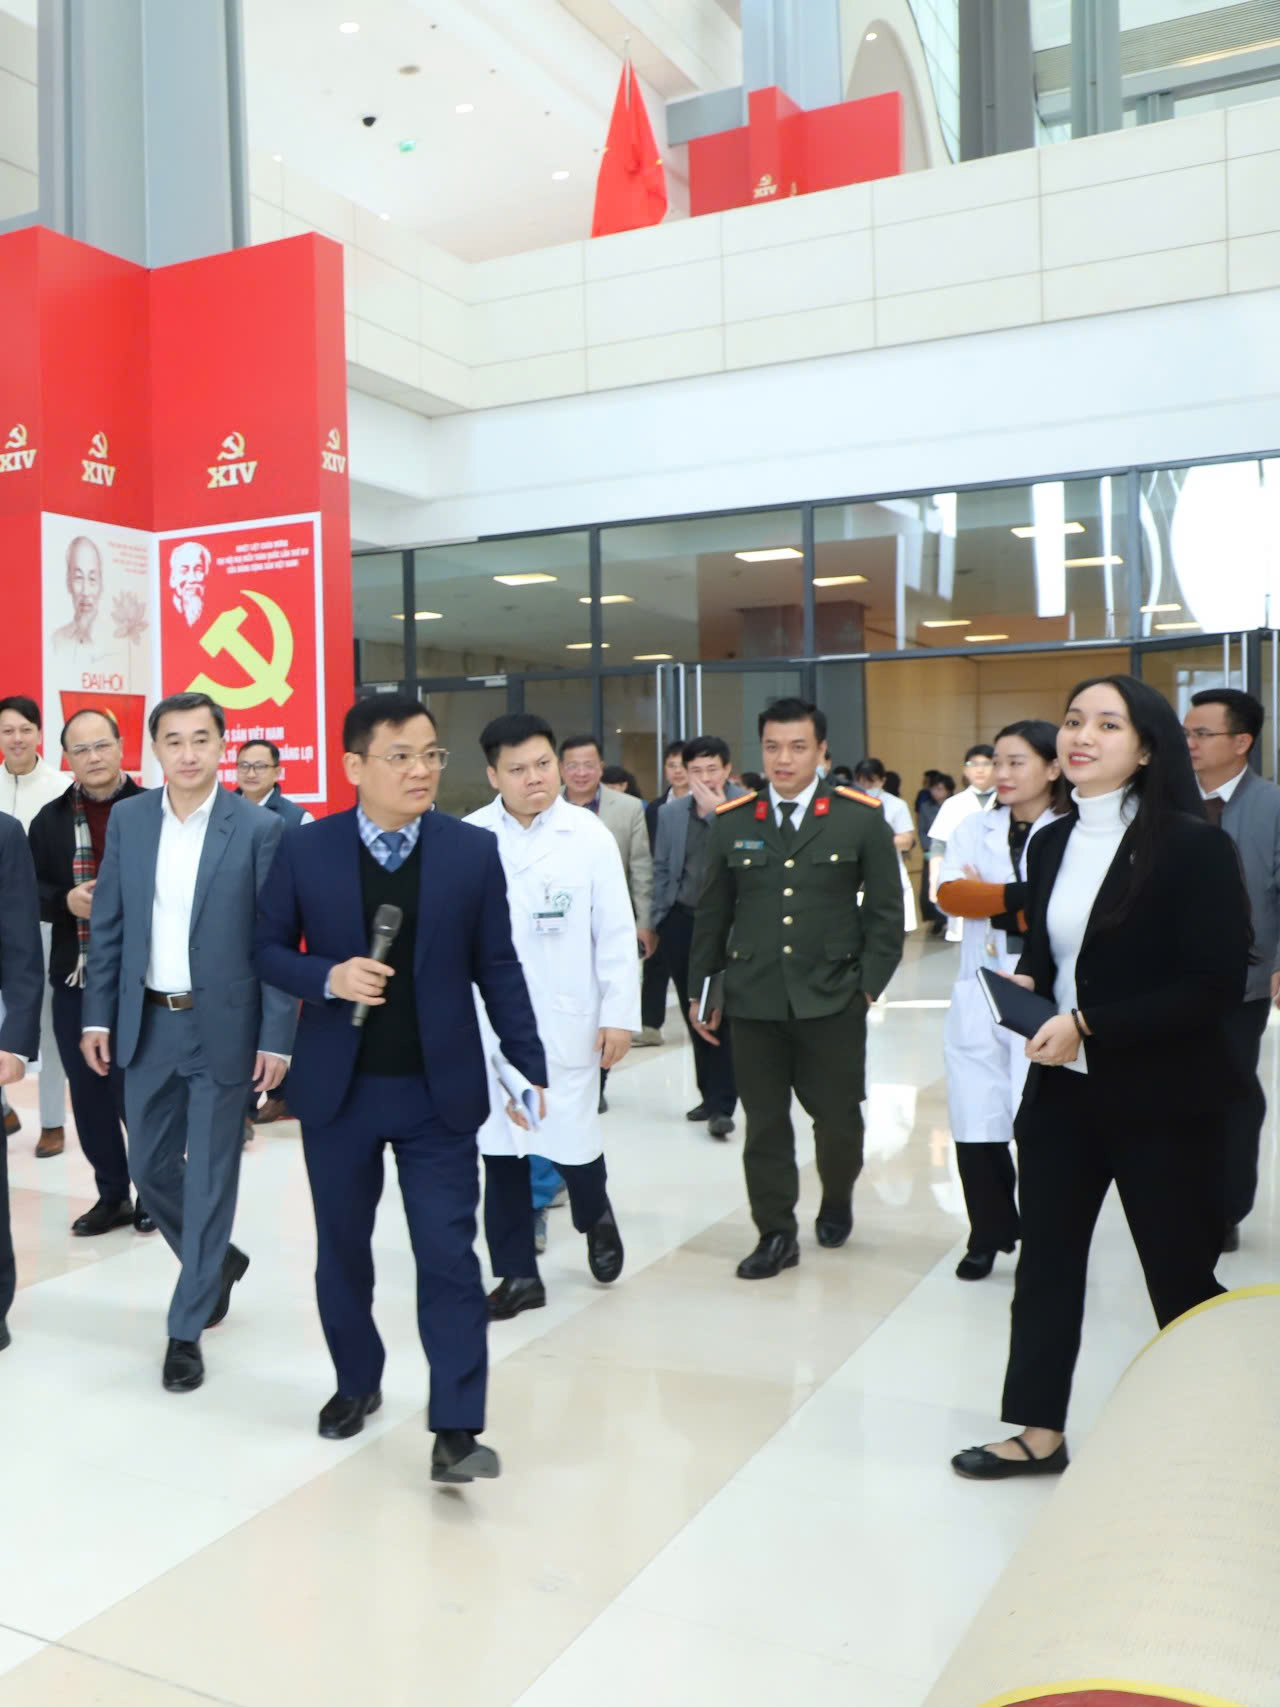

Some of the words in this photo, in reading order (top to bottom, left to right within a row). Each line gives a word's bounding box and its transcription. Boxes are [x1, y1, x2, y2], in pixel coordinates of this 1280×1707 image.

[81, 460, 116, 487] XIV
[207, 461, 258, 489] XIV
[321, 451, 346, 474] XIV
